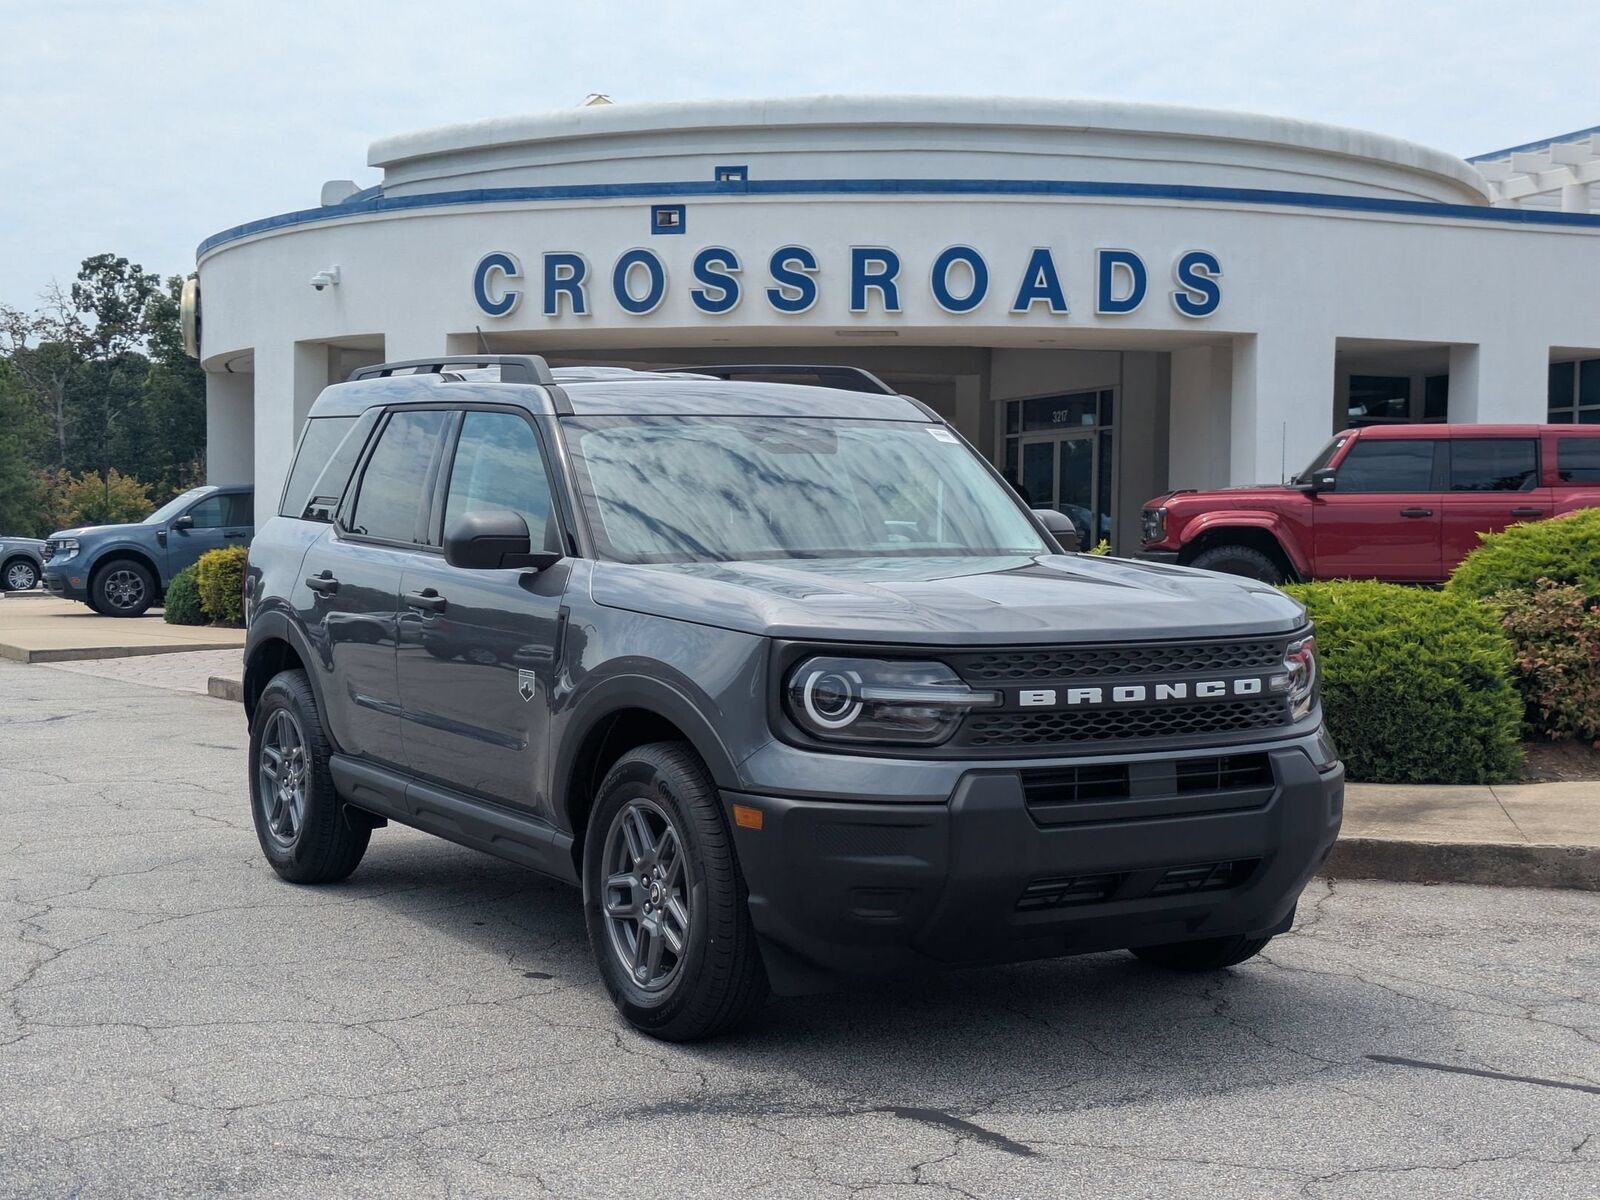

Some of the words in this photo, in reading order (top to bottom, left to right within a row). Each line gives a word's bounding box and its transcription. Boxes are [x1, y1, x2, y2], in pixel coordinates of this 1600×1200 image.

[474, 244, 1223, 318] CROSSROADS
[1052, 410, 1068, 423] 3217
[1019, 678, 1262, 706] BRONCO
